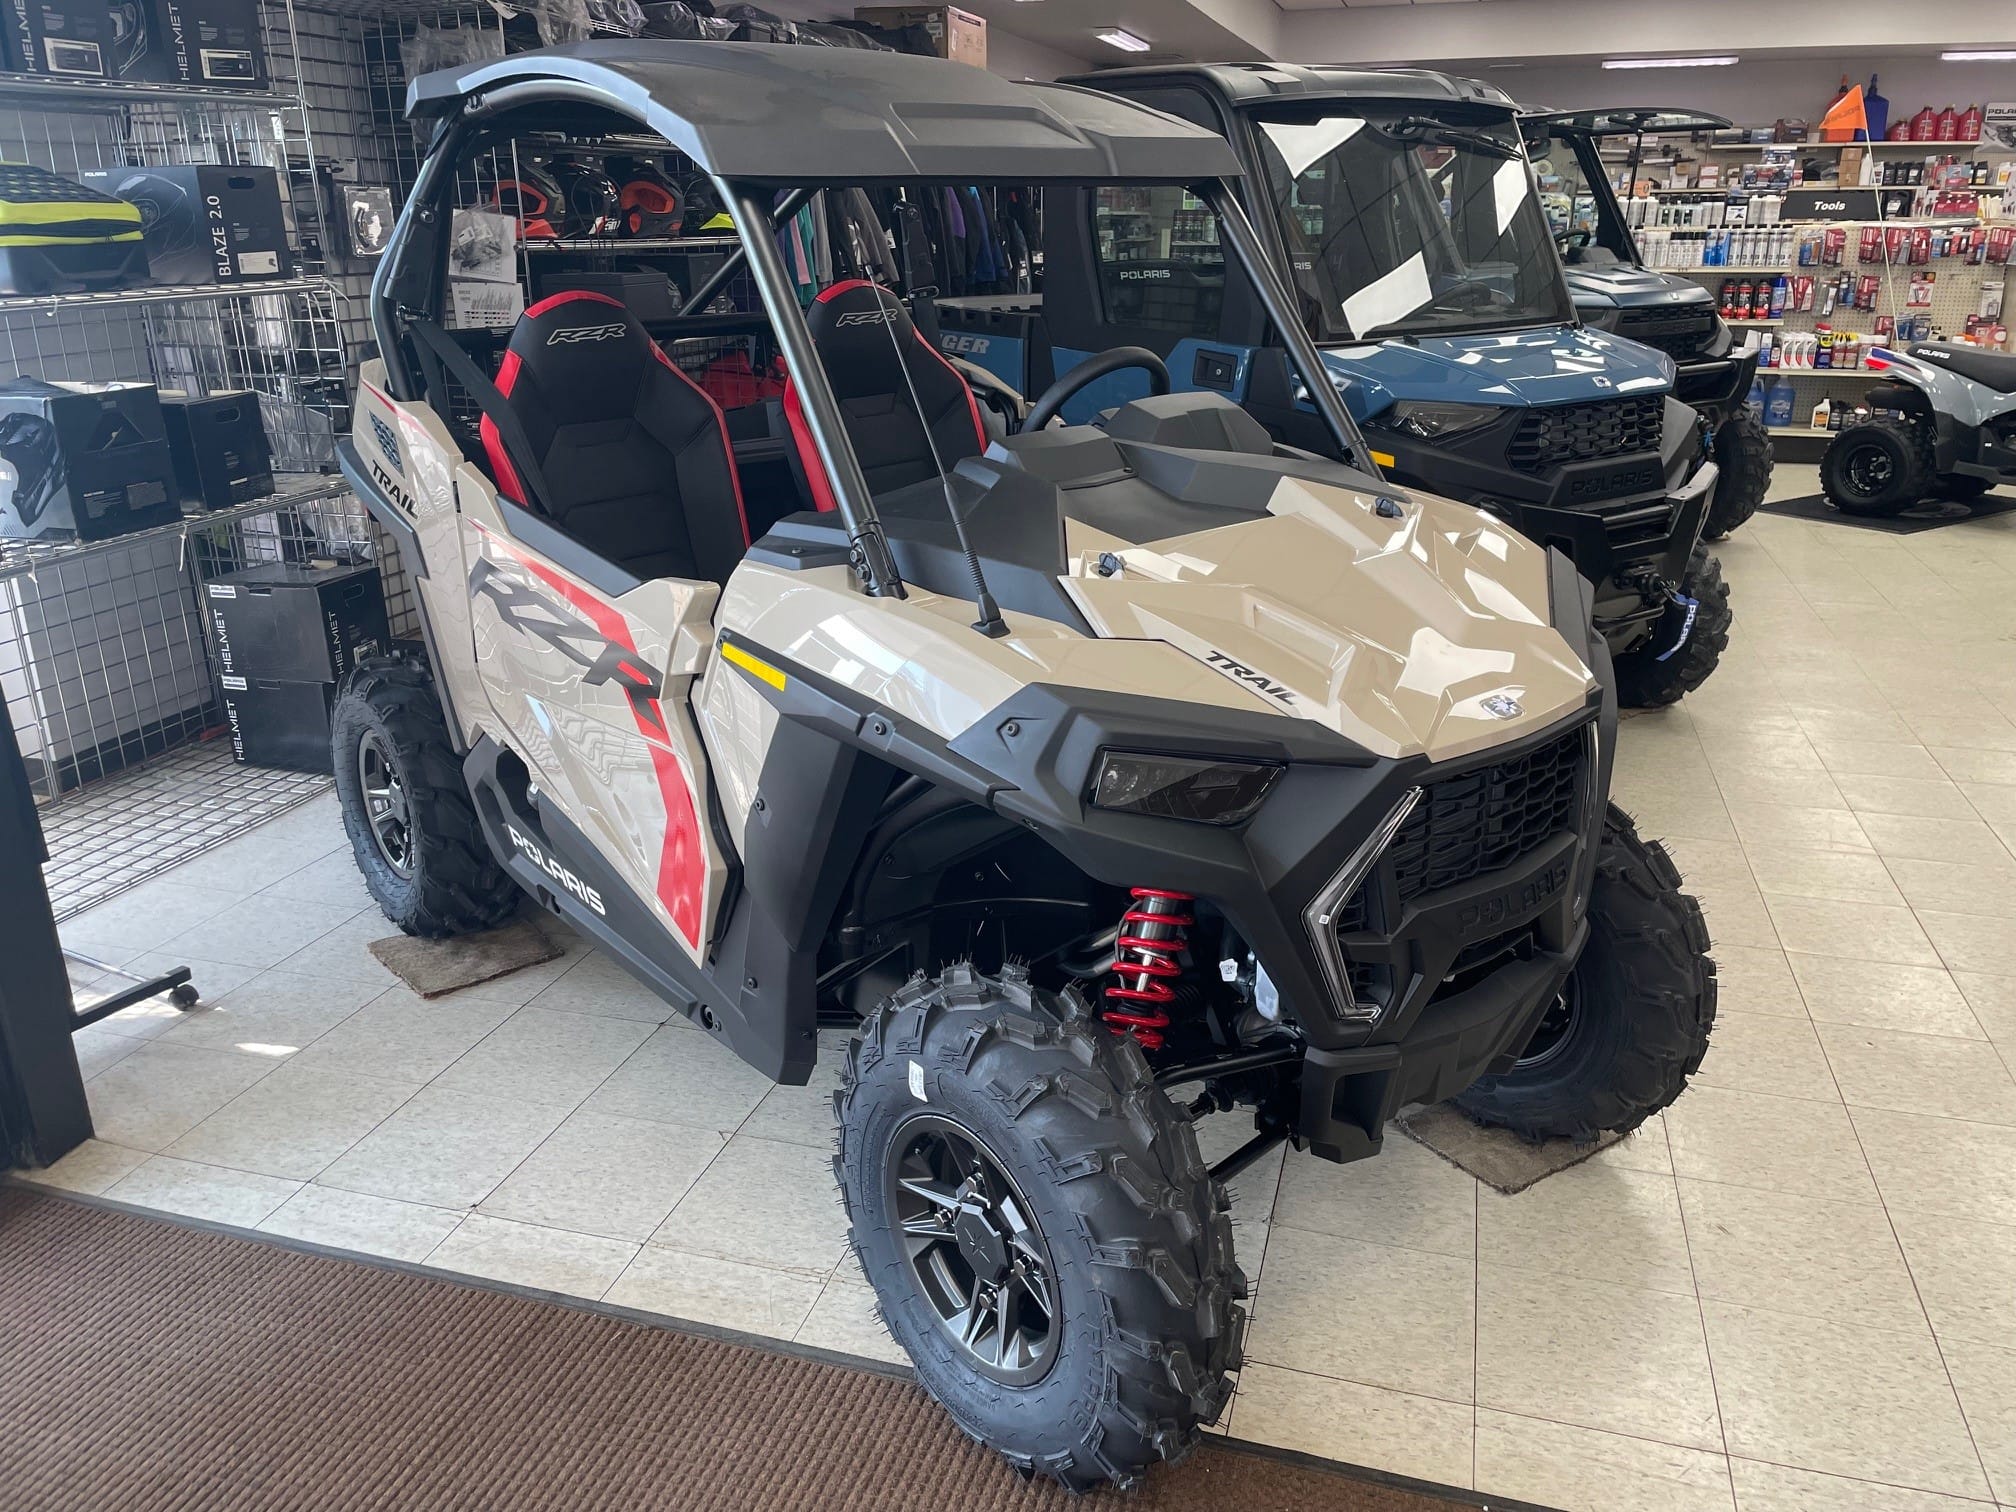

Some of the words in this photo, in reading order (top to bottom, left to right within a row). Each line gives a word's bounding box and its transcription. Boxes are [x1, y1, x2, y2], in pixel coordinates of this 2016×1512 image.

[14, 0, 37, 71] HELME
[168, 2, 190, 81] HELMET
[207, 195, 225, 219] 2.0
[1814, 200, 1847, 212] Tools
[211, 227, 232, 276] BLAZE
[1119, 269, 1171, 280] POLARIS
[546, 323, 627, 346] RZR
[835, 309, 898, 328] RZR
[940, 333, 990, 354] GER
[1916, 348, 1952, 360] POLARIS
[372, 459, 419, 520] TRAIL
[1570, 470, 1655, 498] POLARIS
[213, 608, 235, 673] HELMET
[327, 610, 345, 676] HELMET
[1205, 649, 1298, 706] TRAIL
[226, 699, 246, 761] HELMET
[506, 823, 606, 916] POLARIS
[1456, 861, 1568, 937] POLARIS
